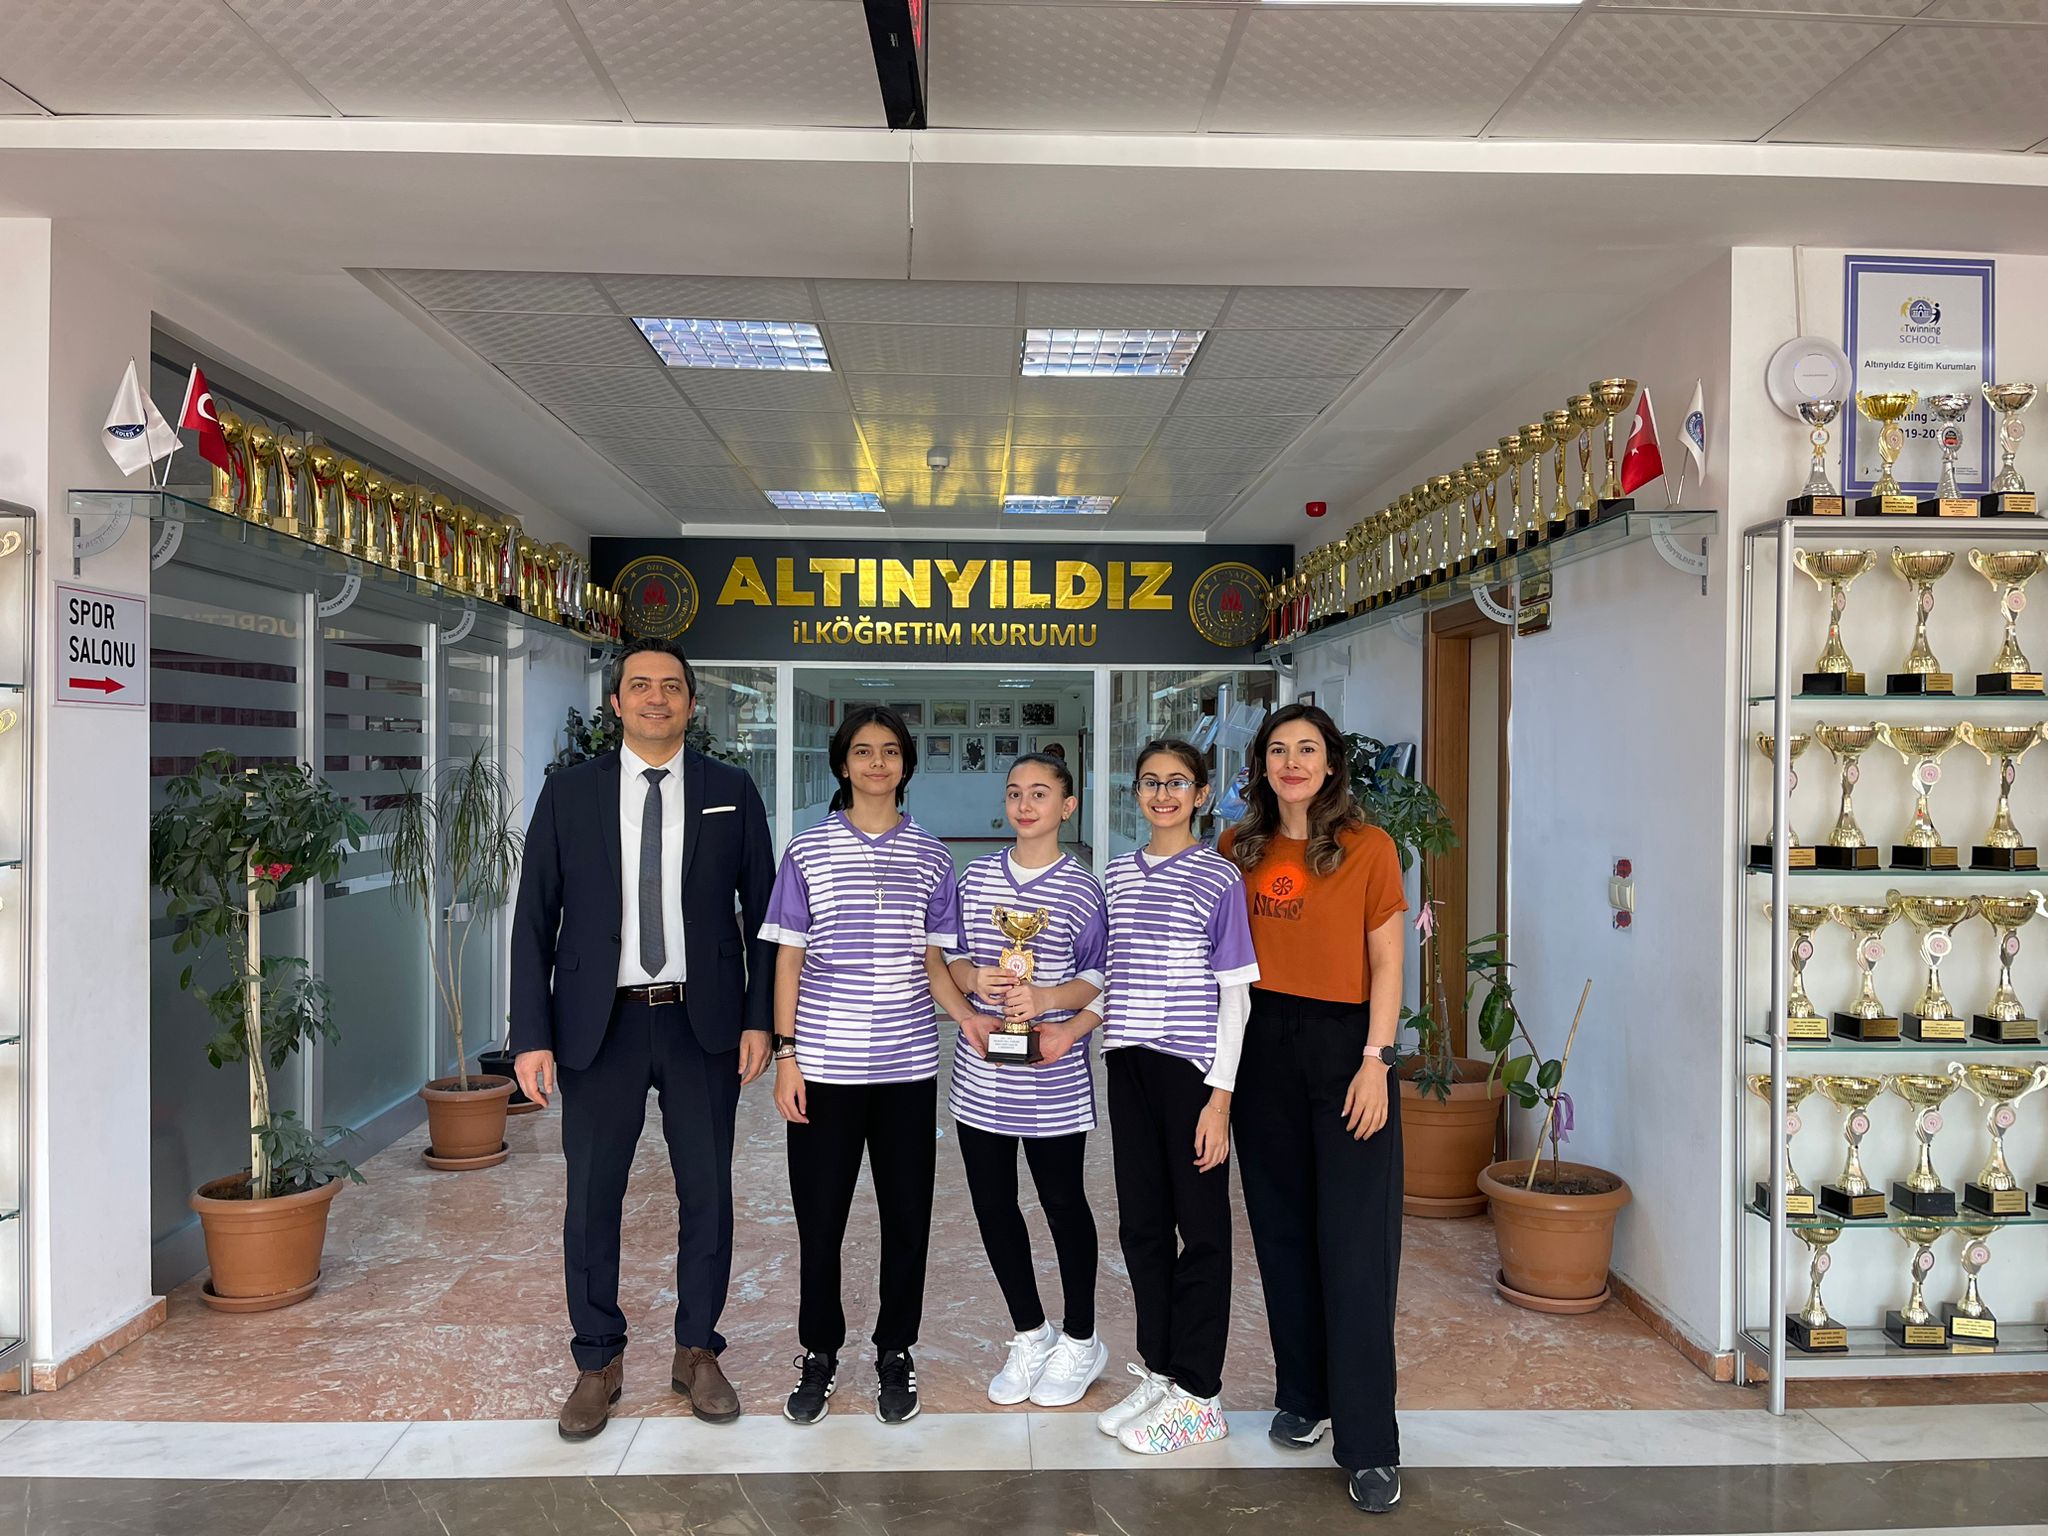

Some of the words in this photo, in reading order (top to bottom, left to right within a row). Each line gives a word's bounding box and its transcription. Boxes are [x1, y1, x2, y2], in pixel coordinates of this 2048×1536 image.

[1899, 334, 1941, 344] SCHOOL
[1907, 361, 1934, 371] Eğitim
[716, 556, 1174, 611] ALTINYILDIZ
[69, 598, 115, 630] SPOR
[971, 622, 1098, 647] KURUMU
[69, 635, 136, 668] SALONU
